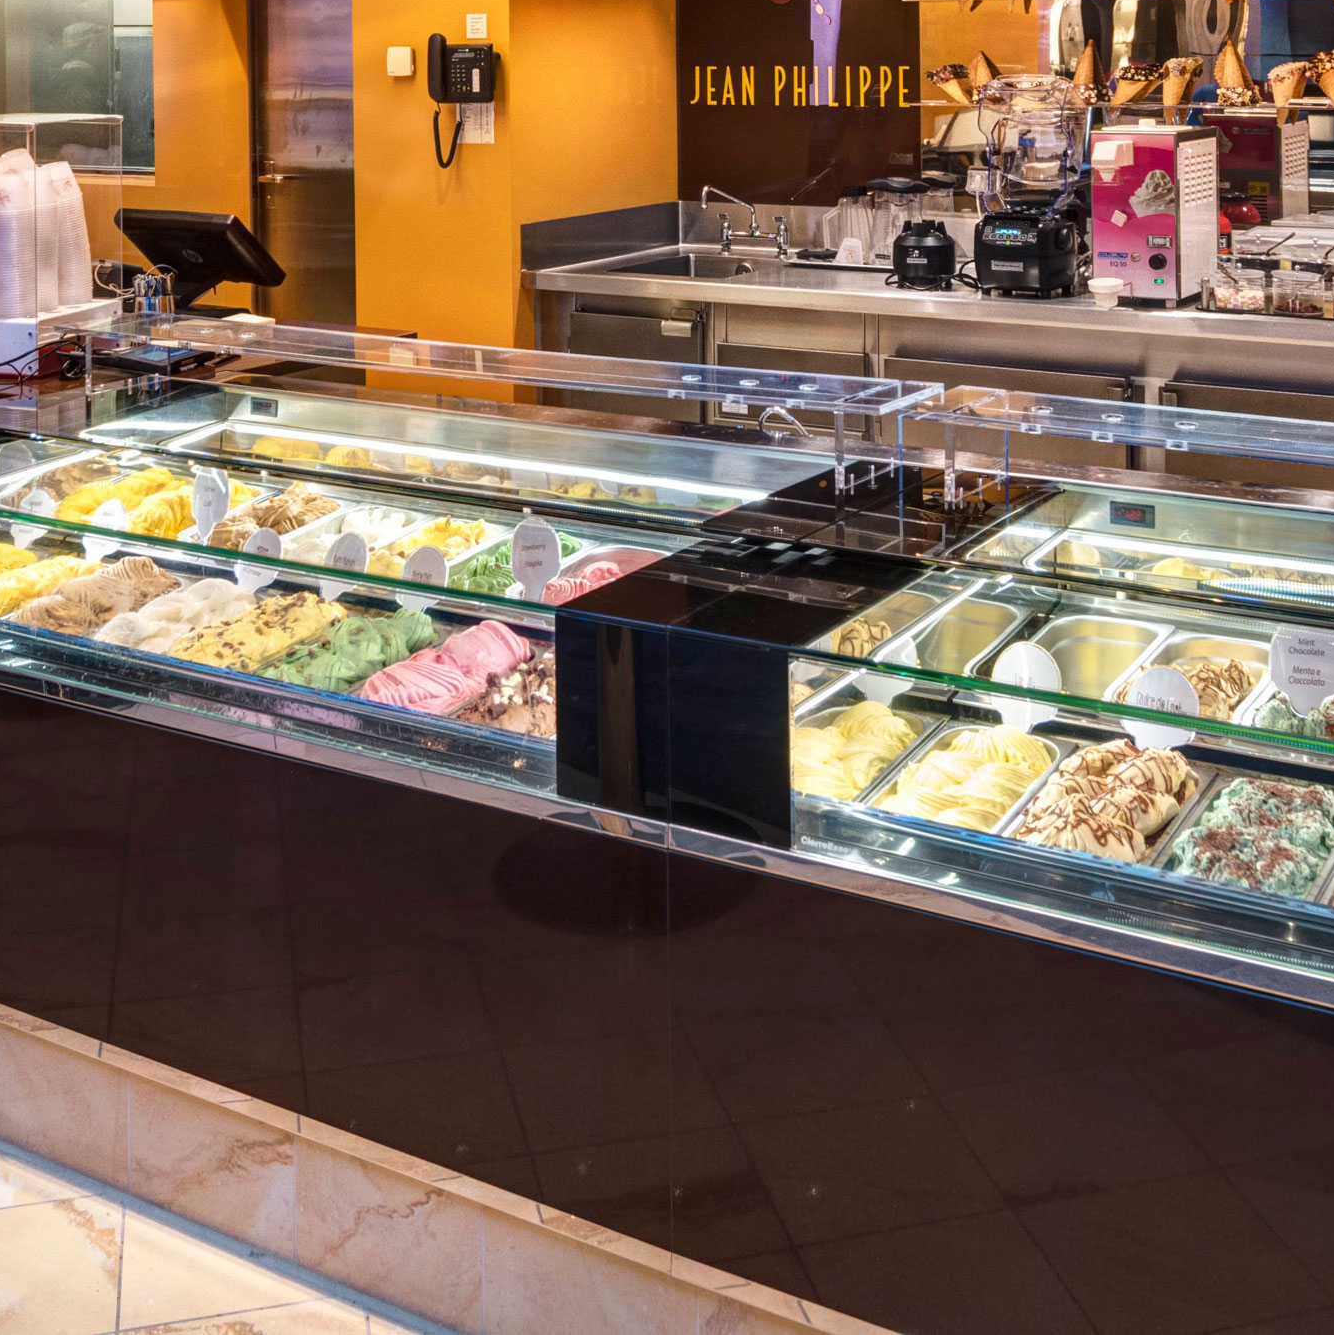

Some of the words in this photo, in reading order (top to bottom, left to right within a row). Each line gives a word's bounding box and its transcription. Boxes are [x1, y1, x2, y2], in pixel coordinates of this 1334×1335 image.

[690, 66, 755, 106] JEAN
[774, 66, 910, 108] PHILIPPE
[1298, 638, 1315, 647] Mint
[1288, 646, 1325, 657] Chocolate
[1292, 666, 1315, 675] Menta
[1288, 676, 1326, 687] Cioccolato
